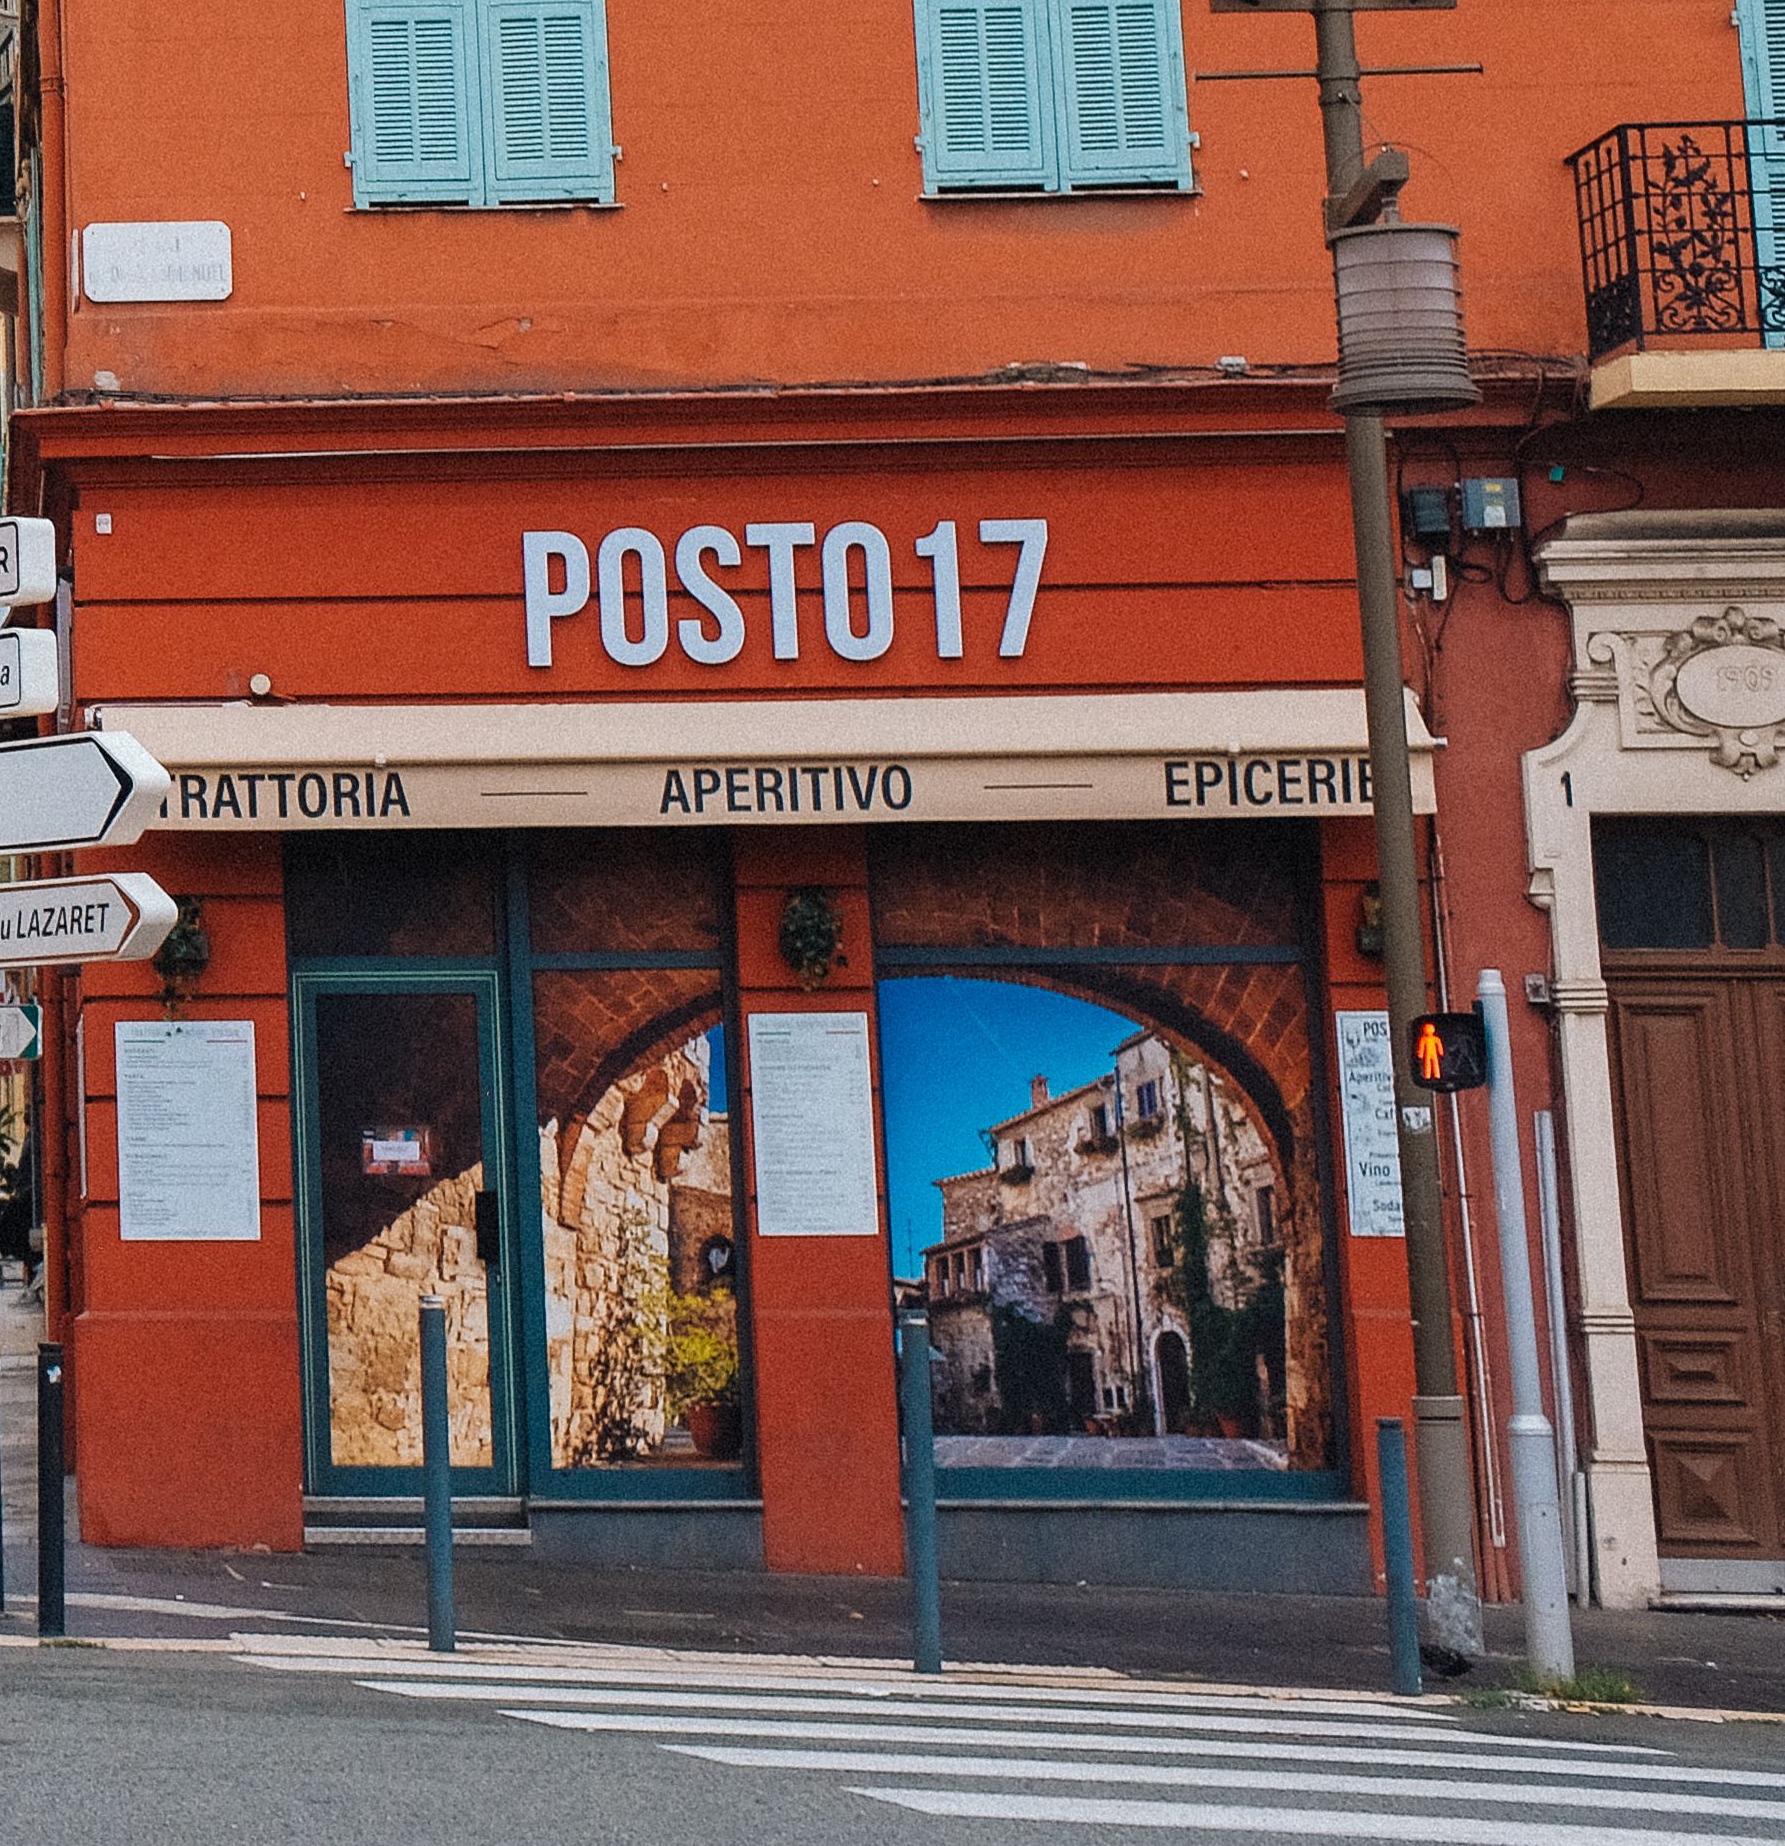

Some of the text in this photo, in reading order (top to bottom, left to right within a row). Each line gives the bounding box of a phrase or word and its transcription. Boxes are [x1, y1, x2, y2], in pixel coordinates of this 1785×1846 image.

[659, 764, 913, 815] APERITIVO
[1164, 758, 1373, 806] EPICERIE
[1560, 770, 1573, 808] 1
[15, 902, 110, 940] LAZARET
[1359, 1161, 1391, 1178] Vino
